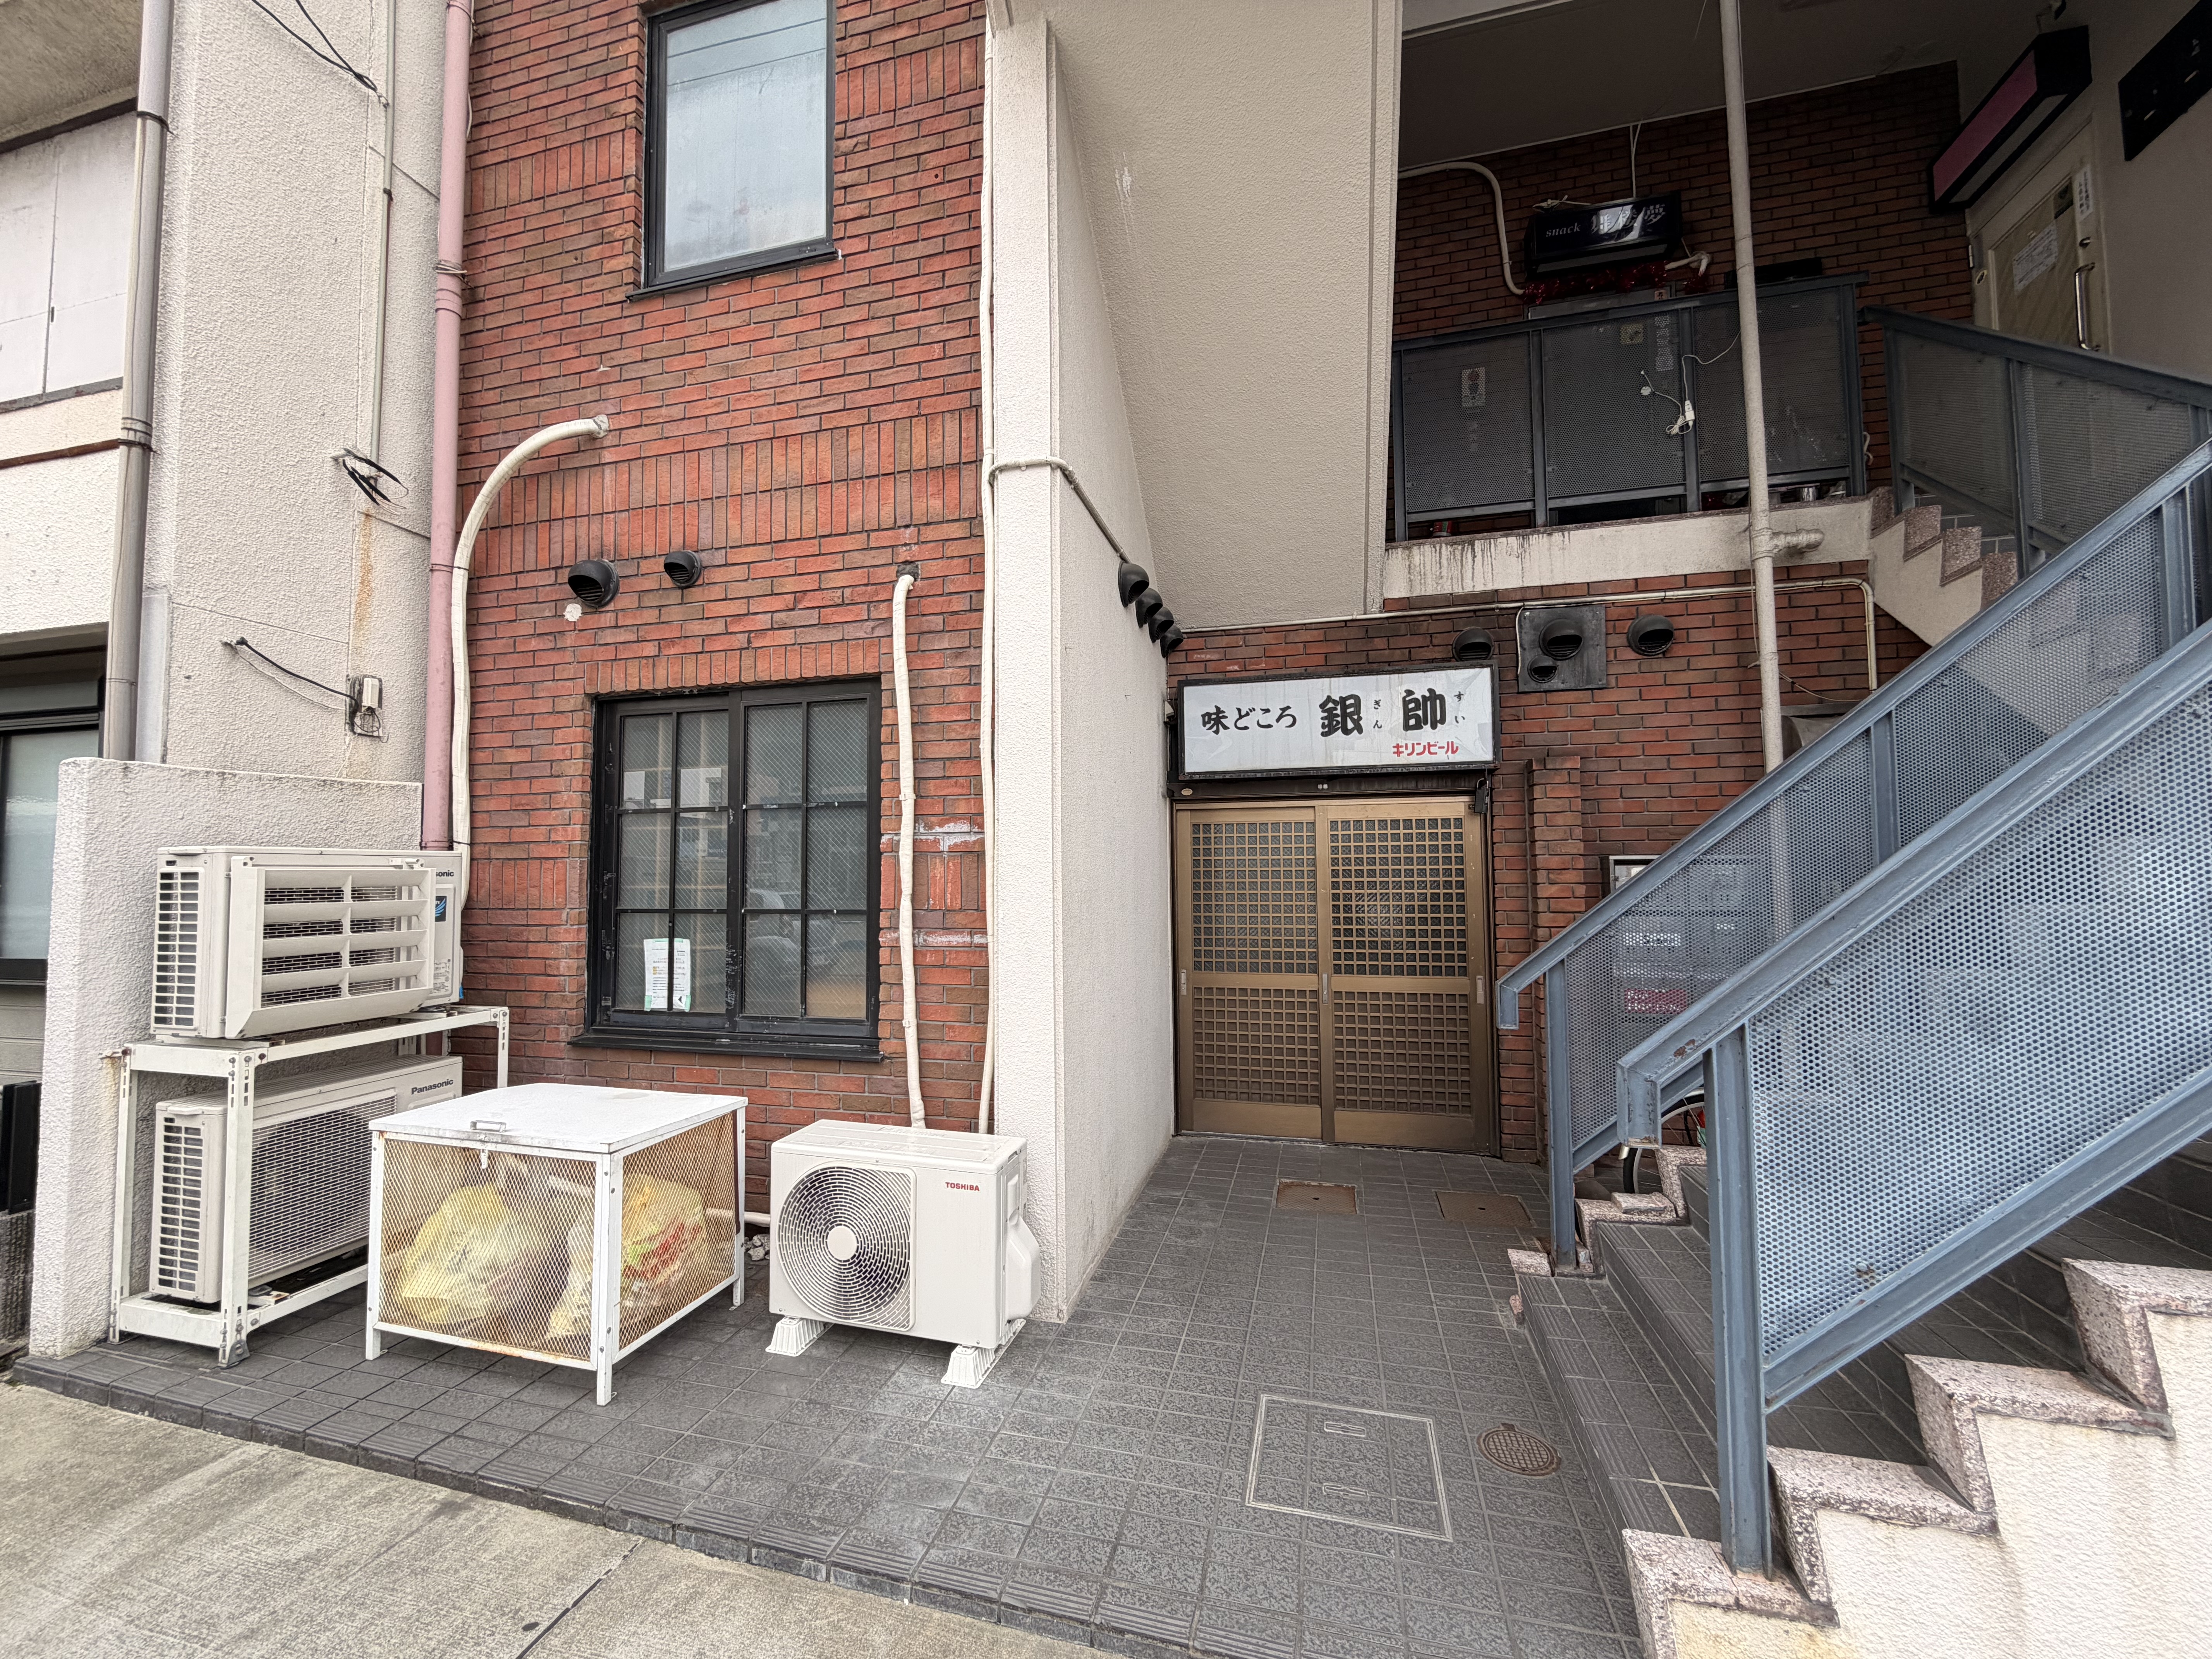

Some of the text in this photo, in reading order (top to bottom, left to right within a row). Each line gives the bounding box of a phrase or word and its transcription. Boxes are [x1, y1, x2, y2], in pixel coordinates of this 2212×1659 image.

[1545, 222, 1582, 237] snack
[1200, 705, 1297, 735] 味どころ
[1319, 694, 1363, 737] 銀
[1453, 691, 1465, 724] すい
[1392, 740, 1459, 757] キリンビール
[411, 1078, 454, 1095] Panasonic
[945, 1182, 980, 1192] TOSHIBA
